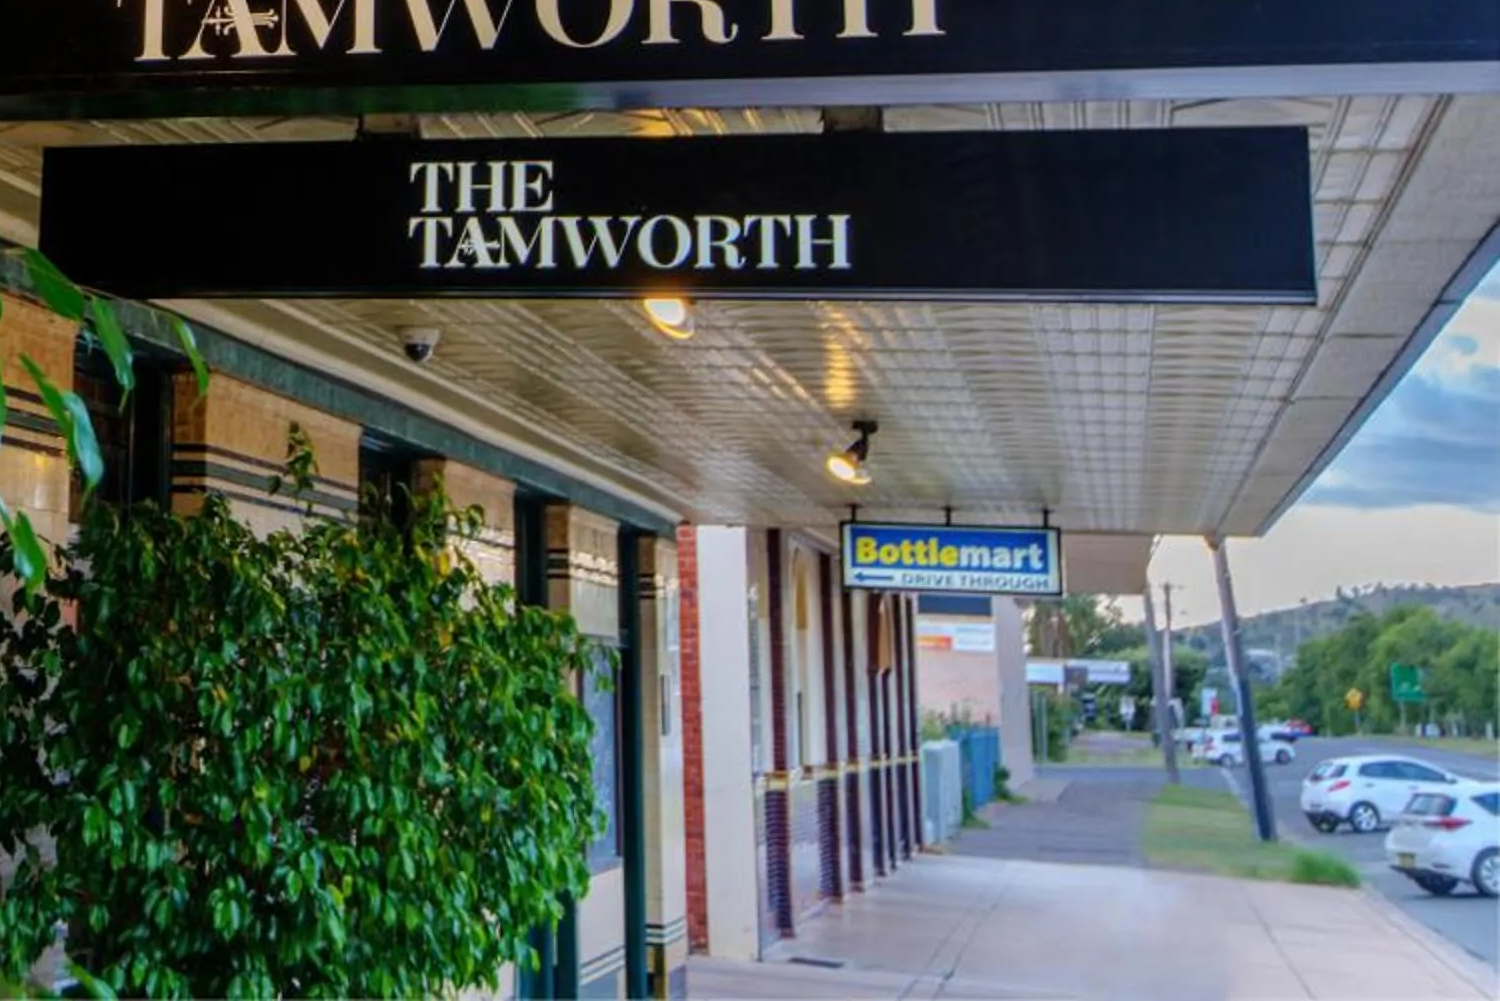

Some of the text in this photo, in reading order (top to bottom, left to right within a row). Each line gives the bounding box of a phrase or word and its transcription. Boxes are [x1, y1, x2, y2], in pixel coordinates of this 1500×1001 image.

[410, 159, 555, 213] THE
[408, 214, 851, 270] TAMWORTH
[854, 536, 1044, 571] Bottlemart
[902, 572, 1049, 589] DRIVE THROUGH
